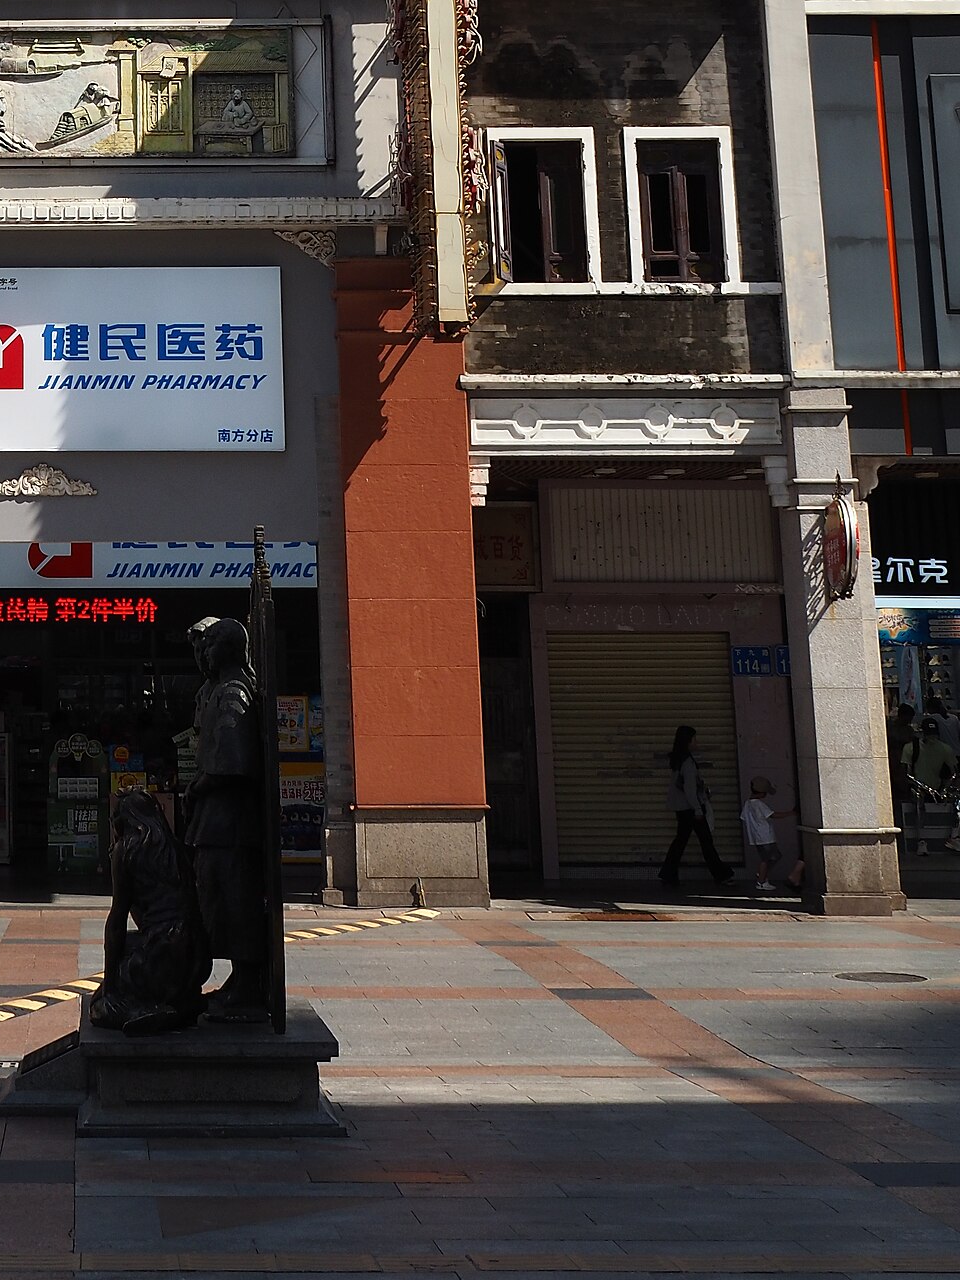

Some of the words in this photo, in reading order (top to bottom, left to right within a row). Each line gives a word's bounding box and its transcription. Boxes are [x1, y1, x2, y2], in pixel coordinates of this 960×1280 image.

[41, 323, 264, 361] 健民医药
[38, 374, 136, 390] JIANMIN
[141, 374, 268, 390] PHARMACY
[217, 428, 274, 443] 南方分店
[106, 562, 204, 578] JIANMIN
[210, 562, 318, 578] PHAMAC
[54, 598, 159, 623] 第2件半价
[736, 659, 760, 673] 114
[780, 659, 791, 673] 1
